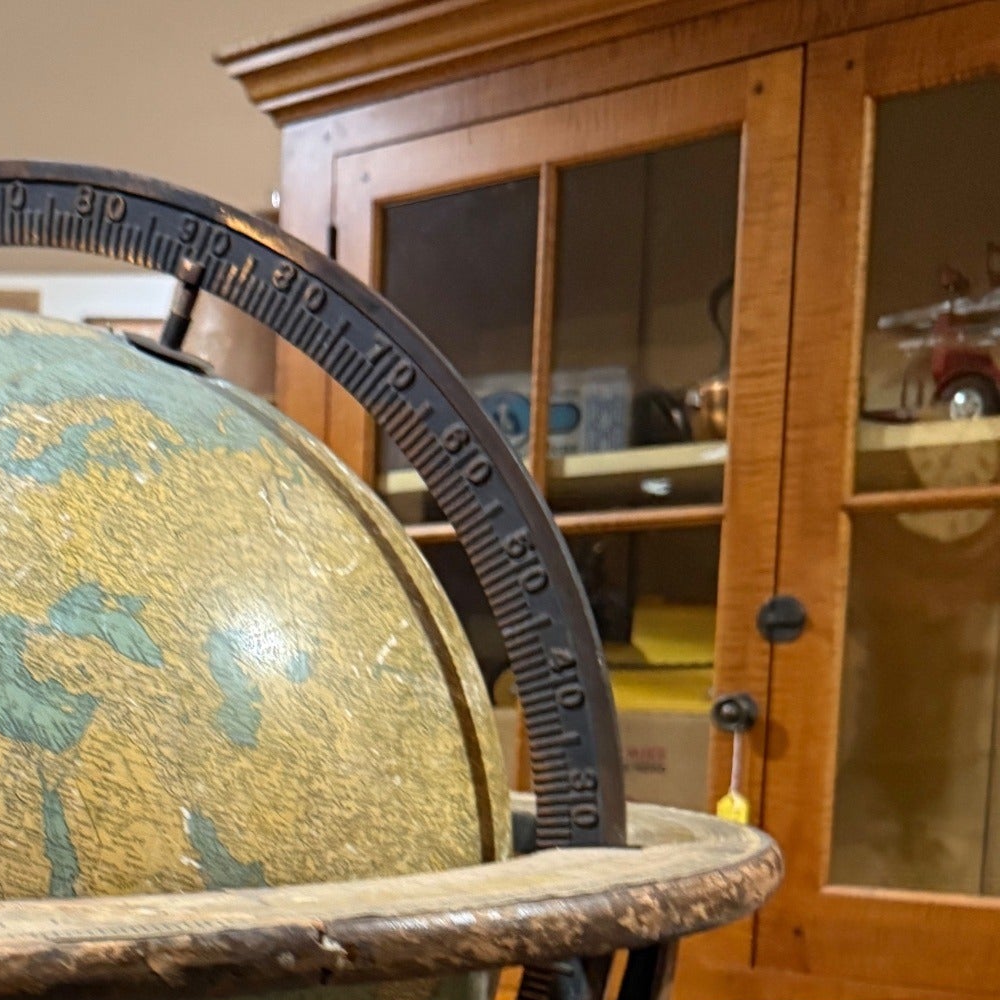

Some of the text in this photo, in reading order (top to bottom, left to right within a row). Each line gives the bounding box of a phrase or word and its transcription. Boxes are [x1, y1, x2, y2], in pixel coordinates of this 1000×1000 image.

[77, 184, 128, 223] 80
[179, 217, 232, 258] 90
[366, 334, 418, 391] 70
[442, 423, 493, 486] 60
[550, 646, 587, 710] 40
[569, 766, 600, 829] 30
